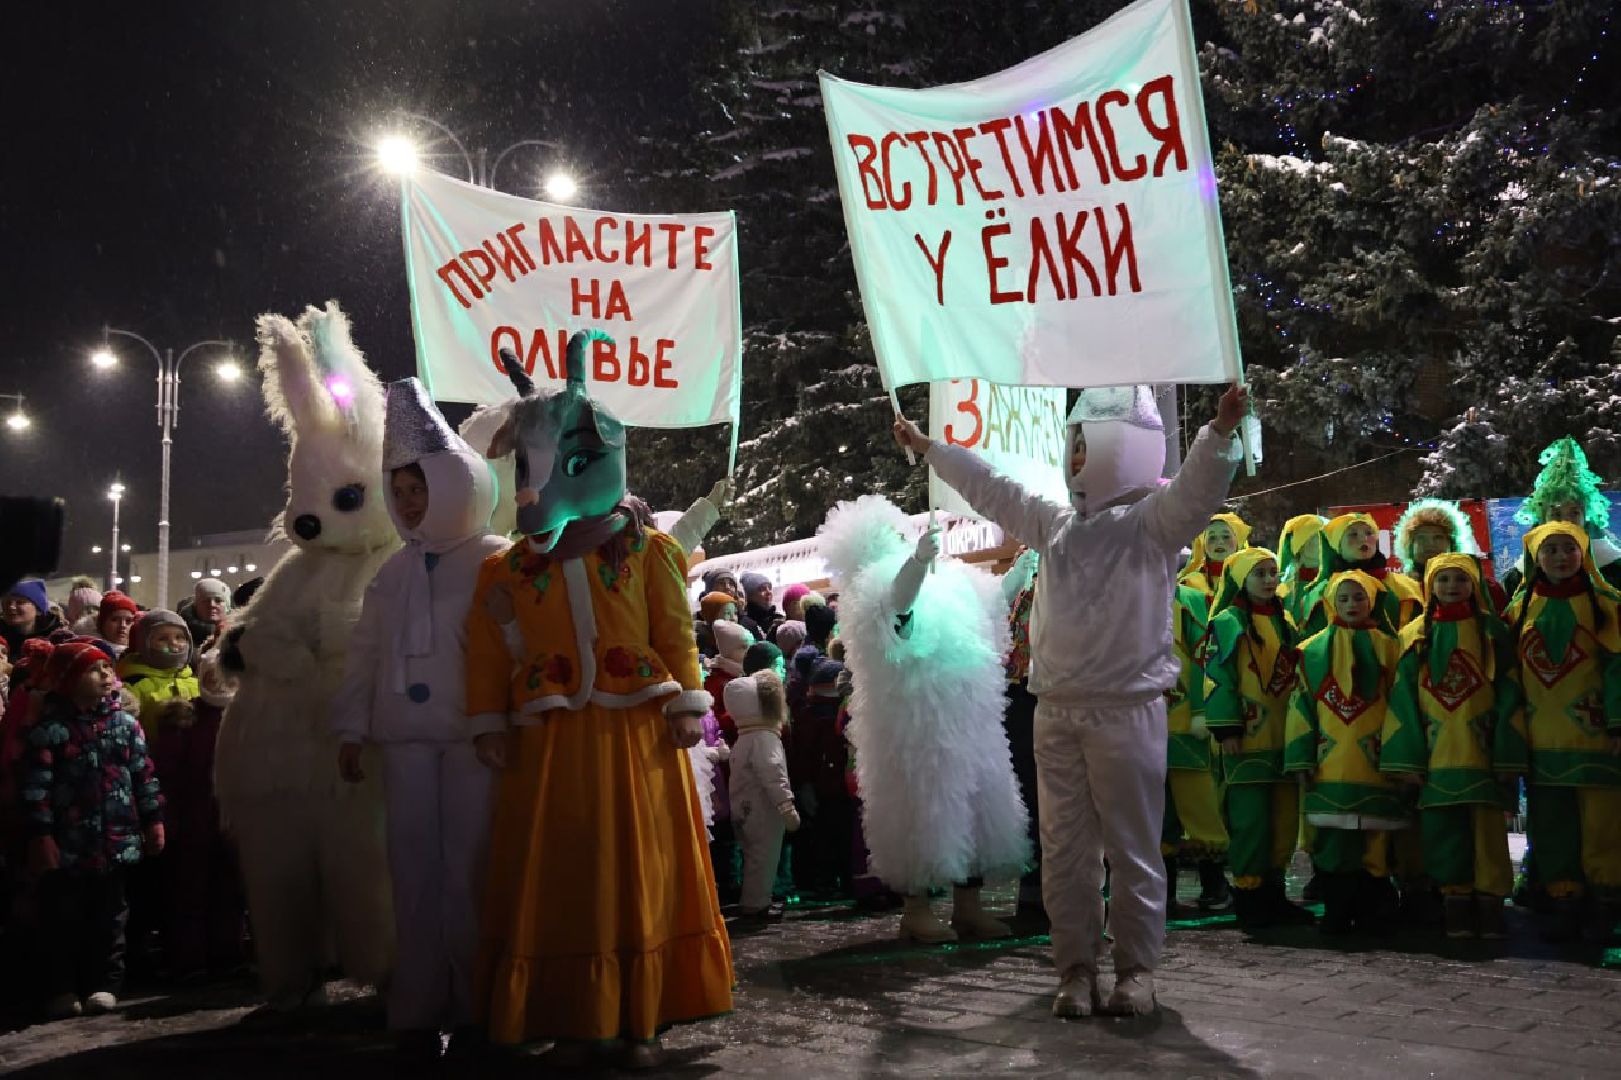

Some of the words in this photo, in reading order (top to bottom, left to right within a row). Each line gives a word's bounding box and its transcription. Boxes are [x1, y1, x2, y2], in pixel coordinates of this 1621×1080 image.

[847, 75, 1188, 211] ВСТРЕТИМСЯ
[437, 216, 715, 308] ПРИГЛАСИТЕ
[571, 278, 632, 321] НА
[915, 230, 952, 305] У
[982, 202, 1142, 304] ЁЛКИ
